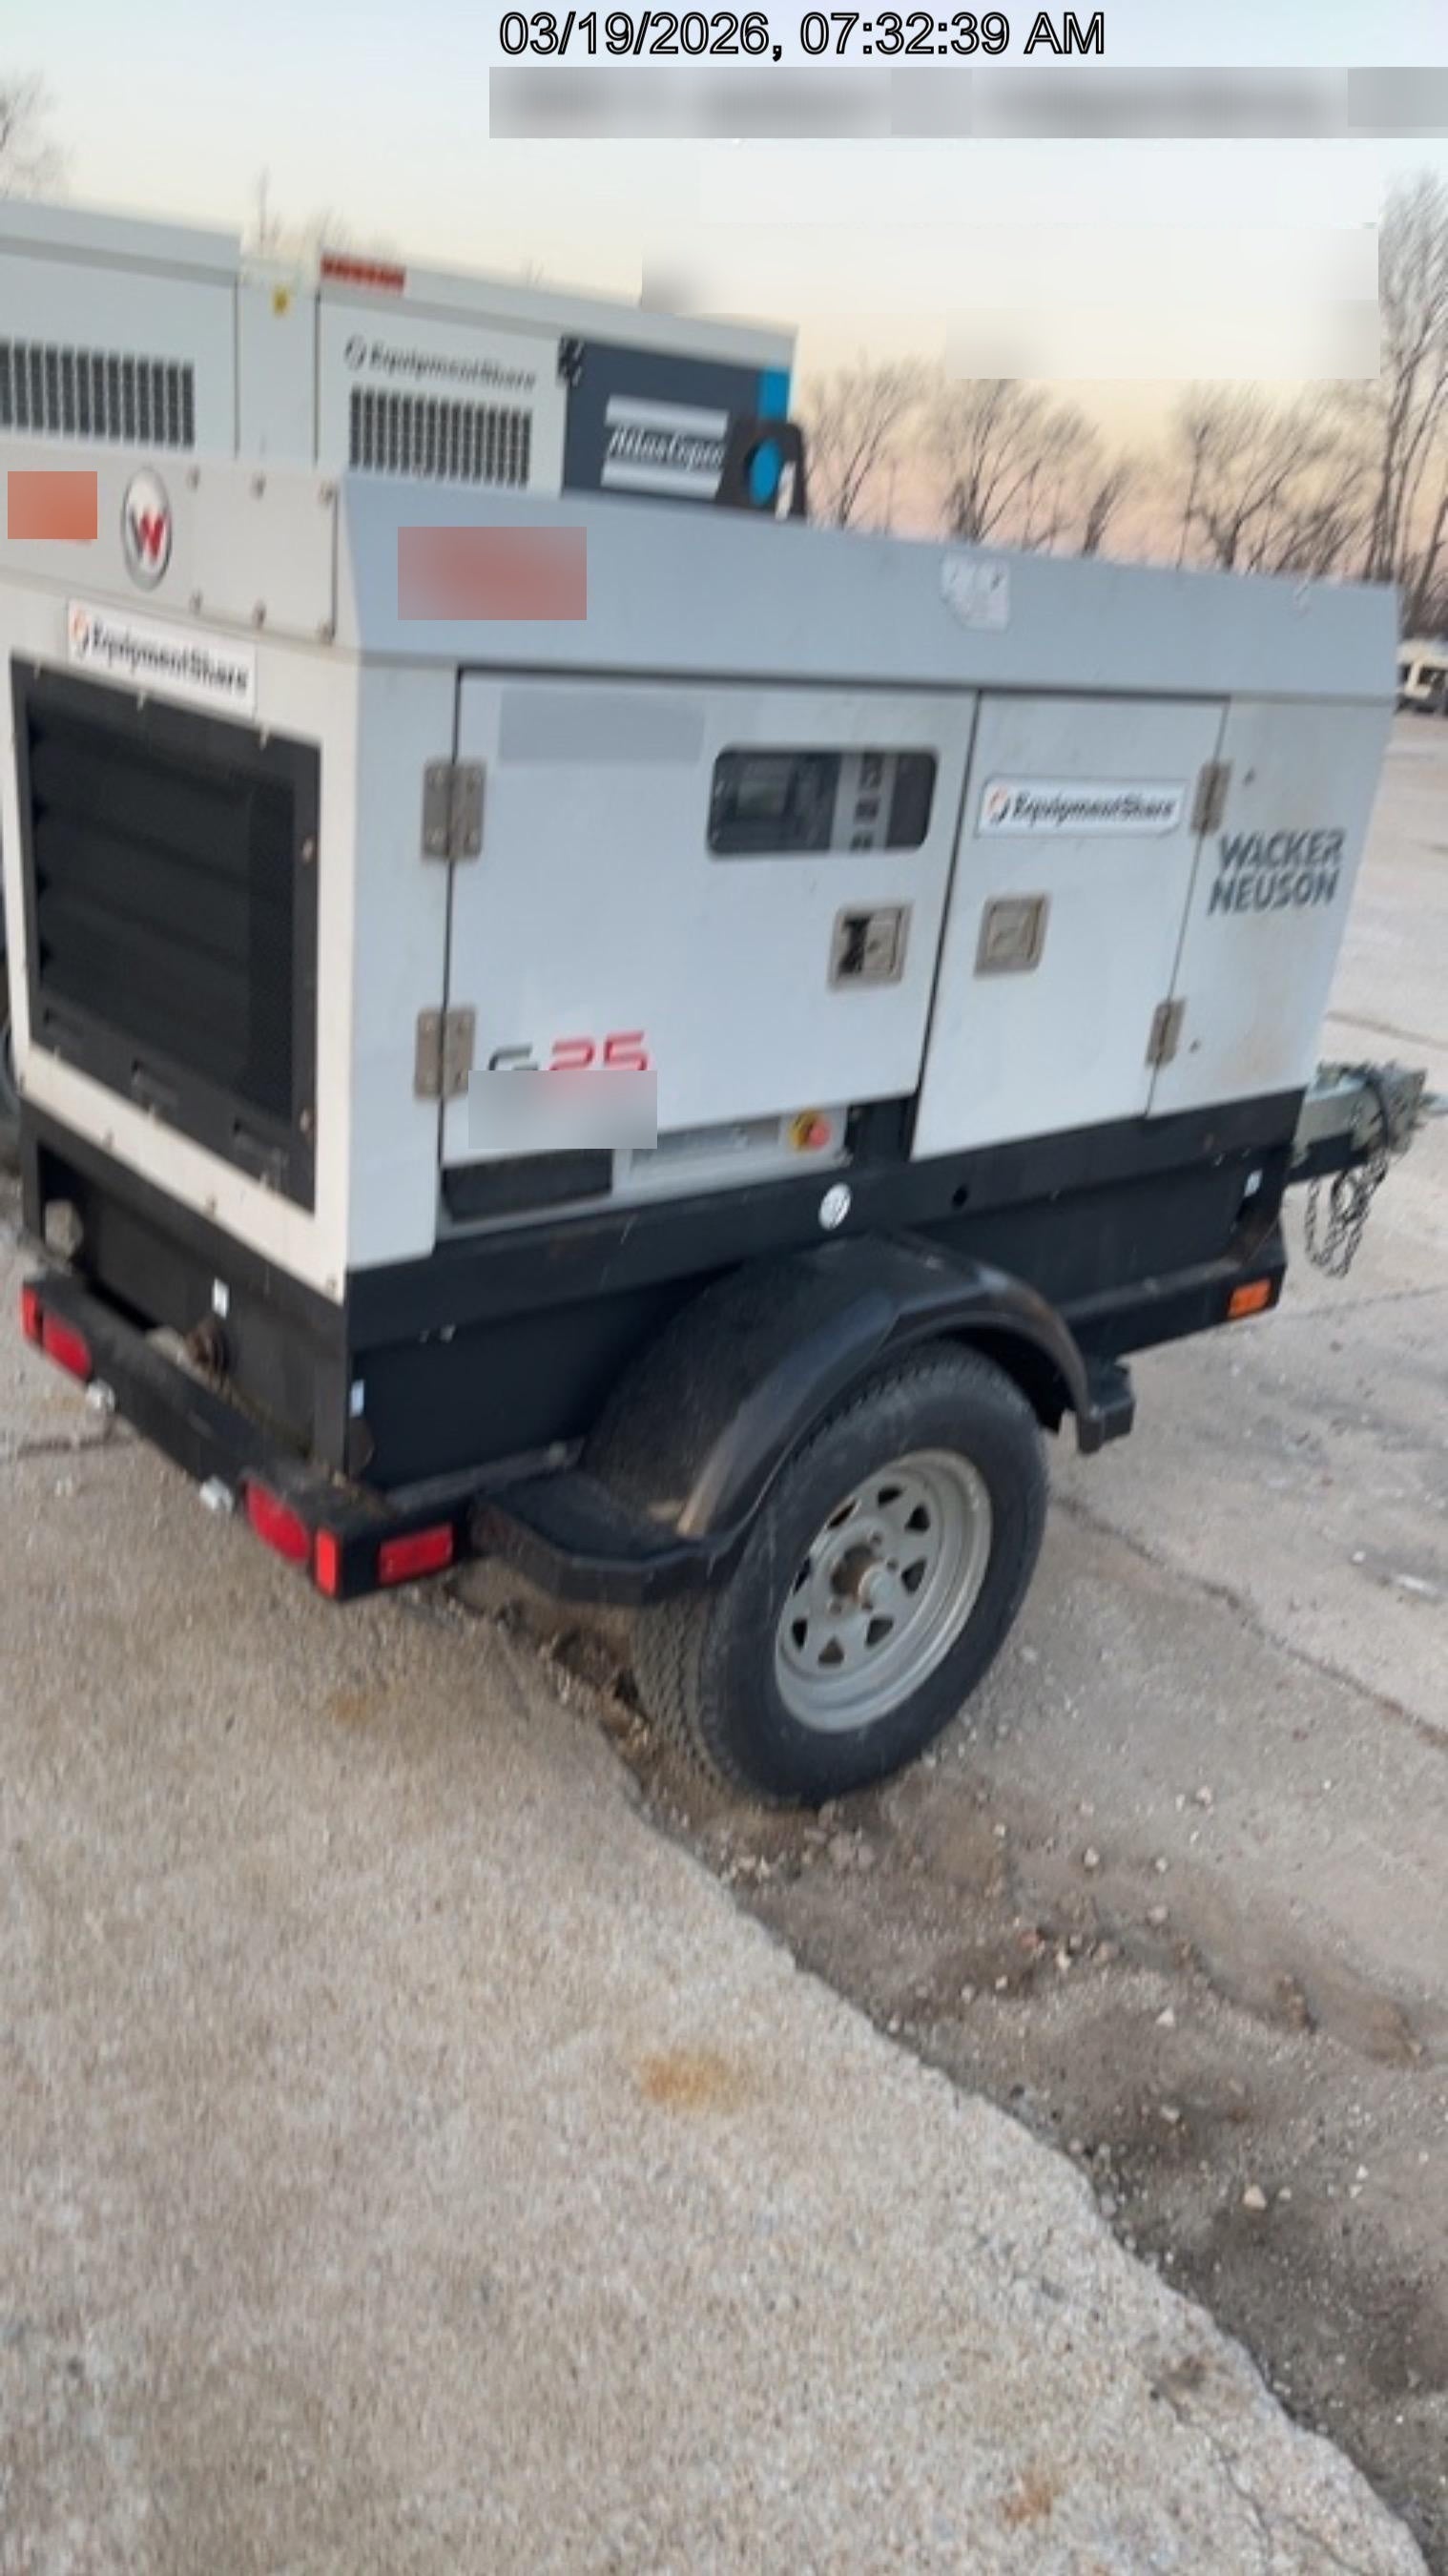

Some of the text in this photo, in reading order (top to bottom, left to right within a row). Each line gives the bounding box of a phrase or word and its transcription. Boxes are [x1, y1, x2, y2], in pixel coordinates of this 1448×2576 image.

[1012, 791, 1176, 827] EquipmentShare
[1218, 829, 1346, 872] WACKER
[1209, 872, 1339, 914] NEUSON
